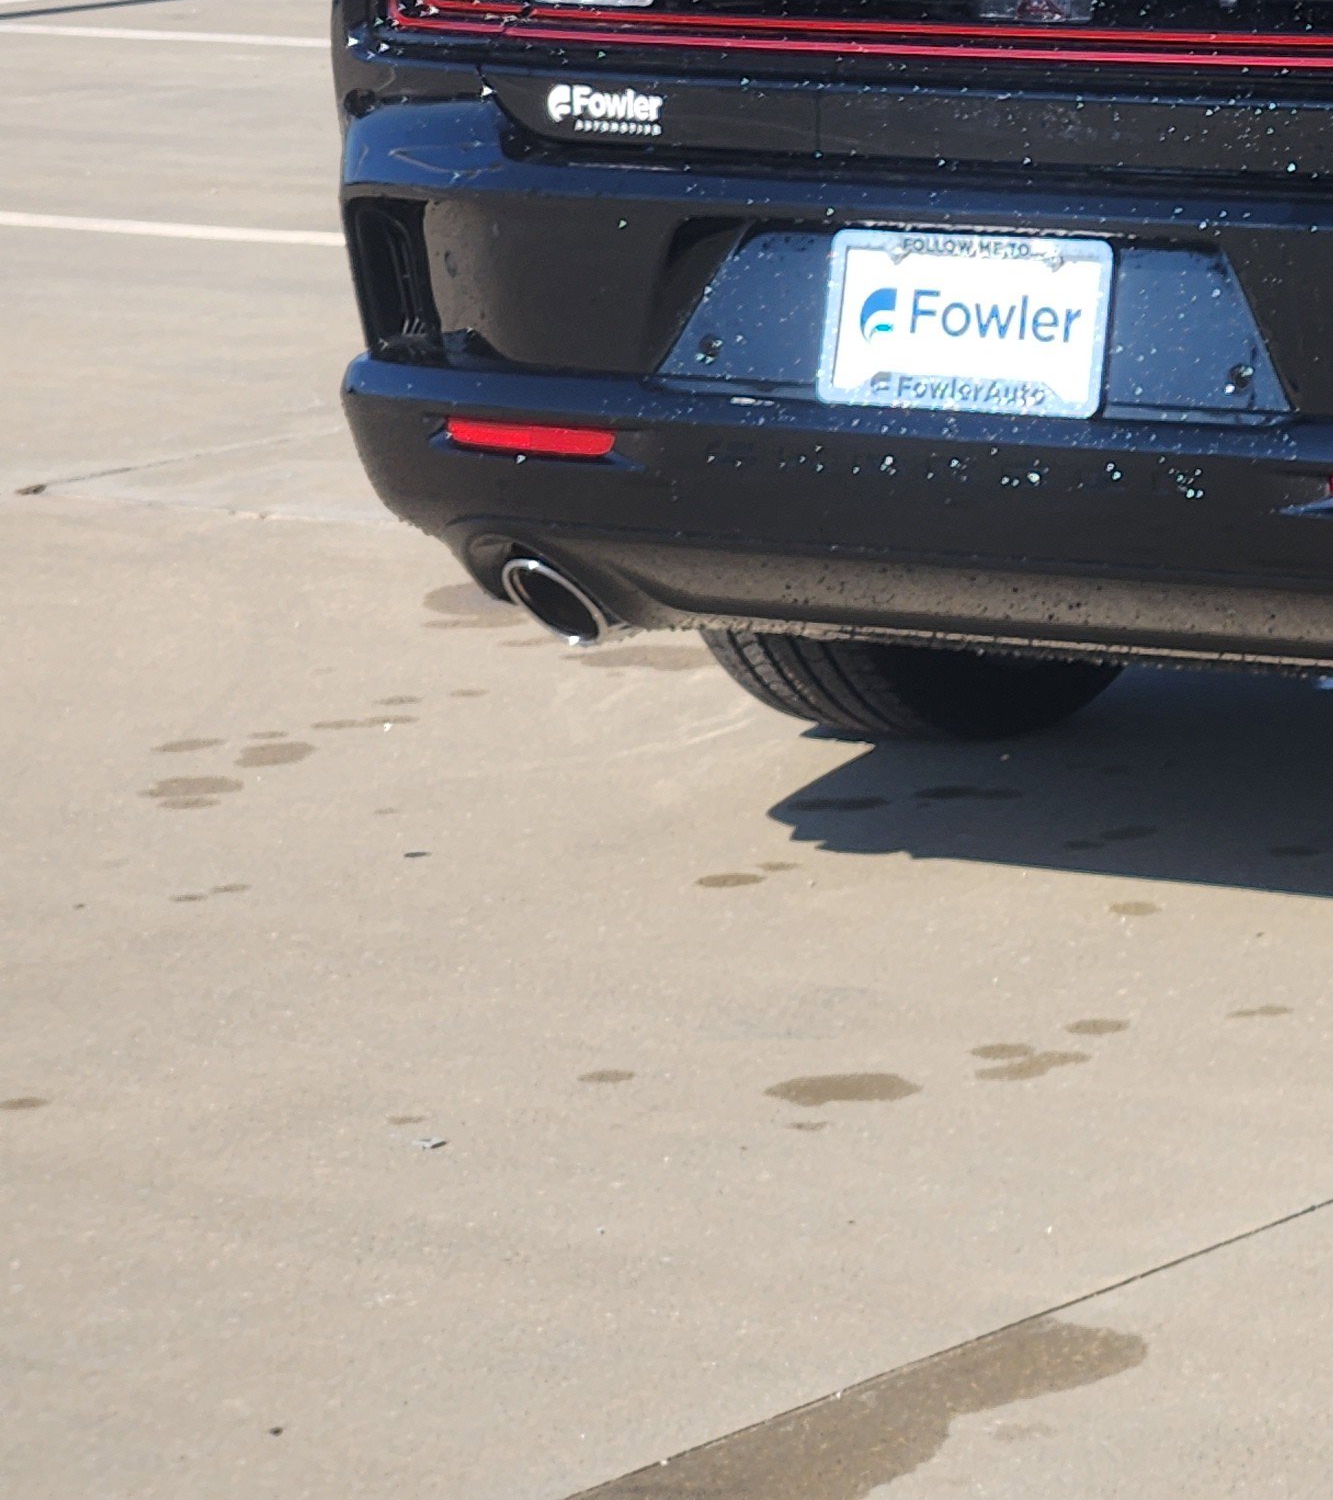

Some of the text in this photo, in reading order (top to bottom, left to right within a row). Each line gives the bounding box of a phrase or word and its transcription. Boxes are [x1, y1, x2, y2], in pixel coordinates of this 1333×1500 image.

[573, 85, 663, 122] Fowler
[903, 238, 972, 254] FOLLOW
[978, 241, 1001, 255] ME
[909, 289, 1082, 343] Fowler
